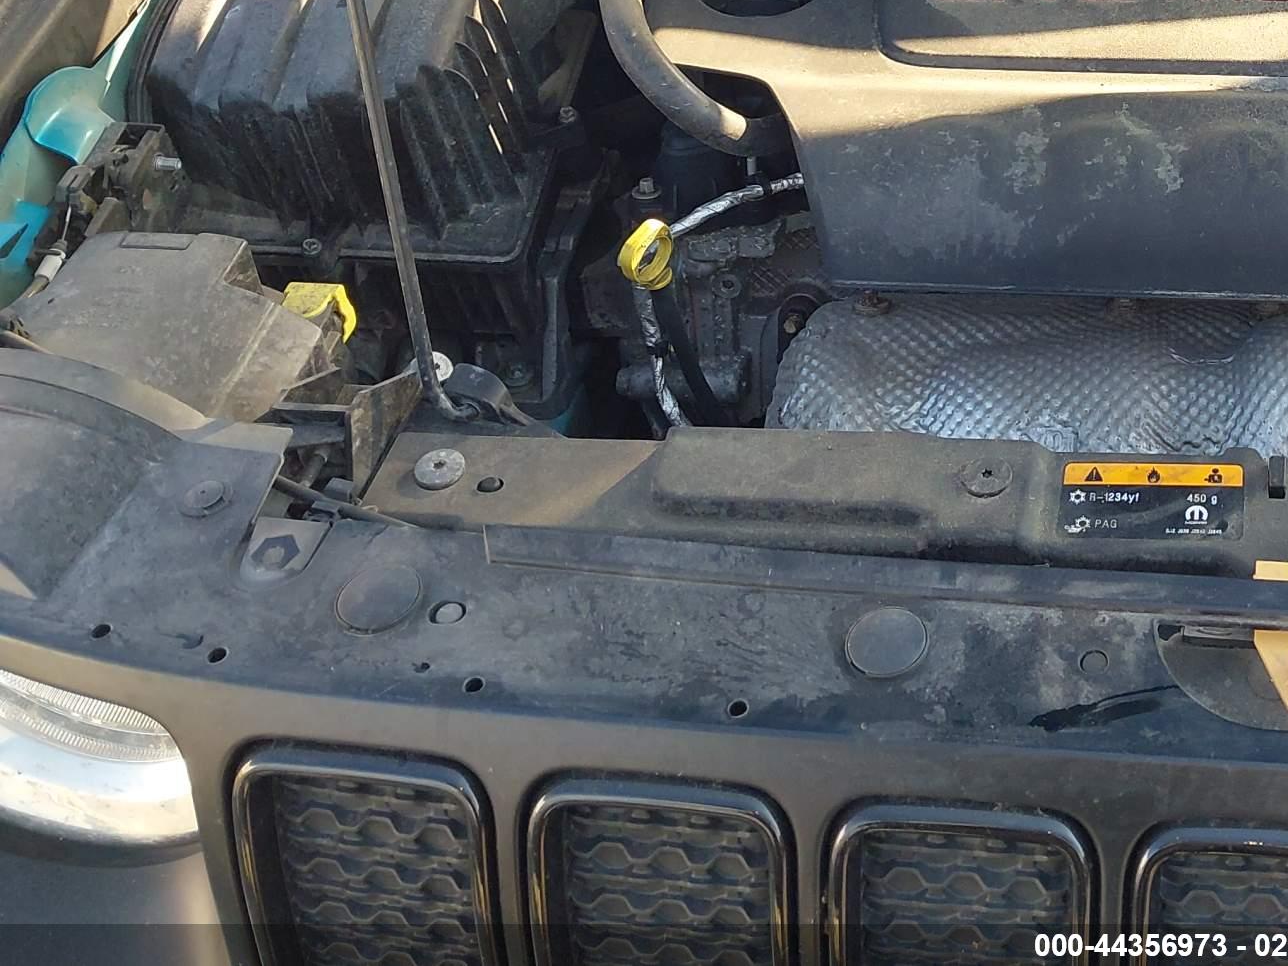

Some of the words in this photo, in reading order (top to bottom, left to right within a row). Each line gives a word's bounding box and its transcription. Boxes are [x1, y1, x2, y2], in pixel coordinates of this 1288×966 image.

[1089, 492, 1140, 504] R-1234yf
[1186, 493, 1207, 503] 450
[1210, 495, 1218, 506] g
[1094, 519, 1118, 529] PAG
